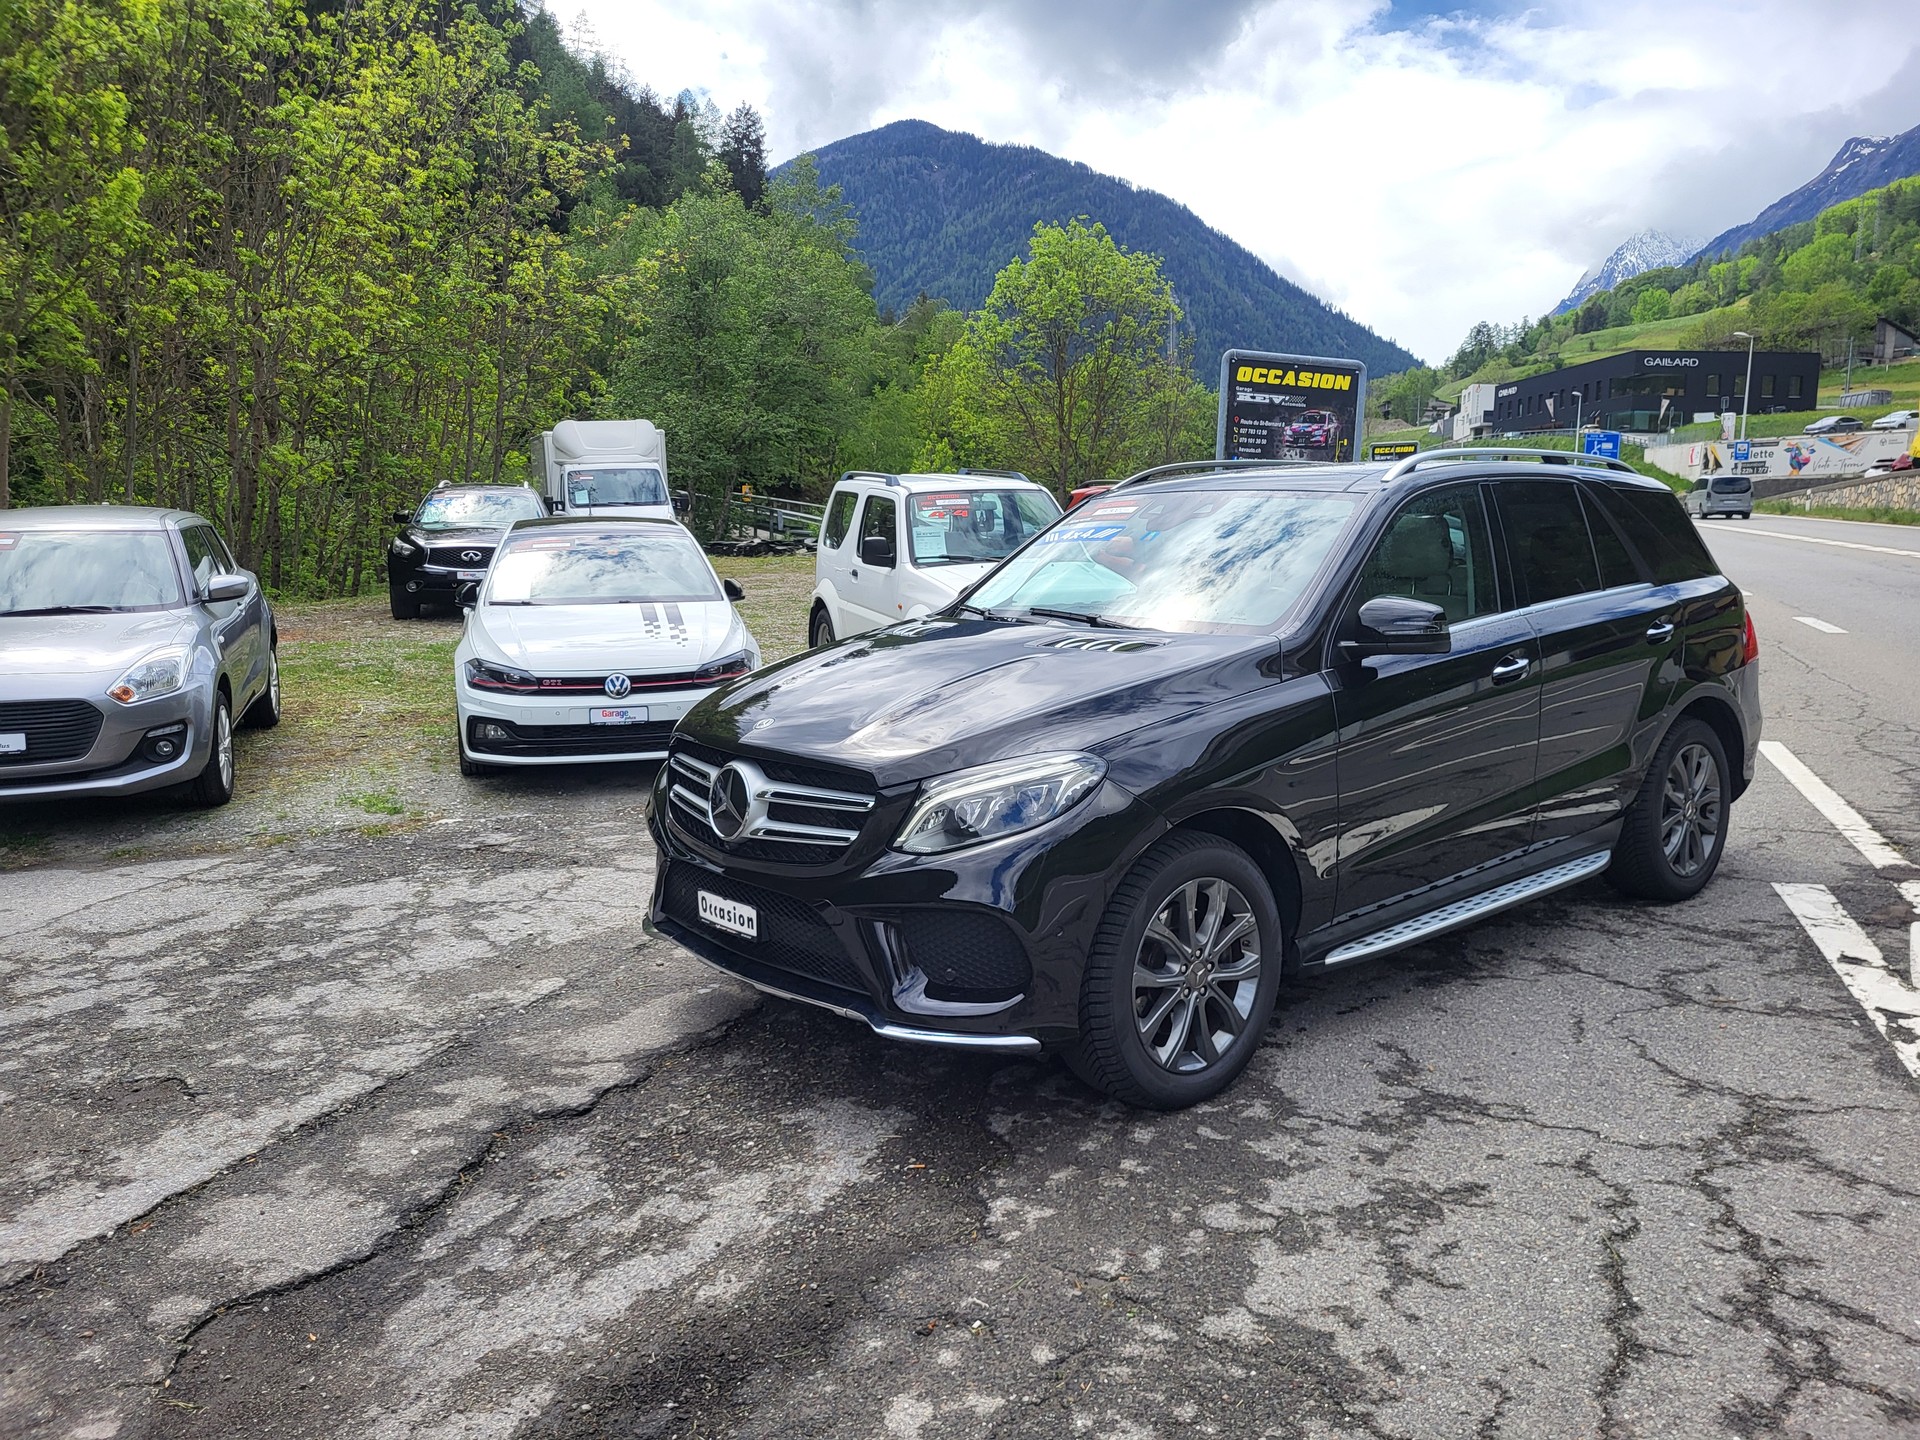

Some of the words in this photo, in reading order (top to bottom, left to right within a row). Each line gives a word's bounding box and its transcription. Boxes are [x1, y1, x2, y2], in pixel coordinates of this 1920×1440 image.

[1644, 357, 1699, 367] GAILLARD
[1236, 366, 1352, 391] OCCASION
[1374, 446, 1415, 454] OCCASION
[1061, 529, 1095, 540] 4x4
[601, 709, 629, 719] Garage
[701, 895, 754, 930] Occasion
